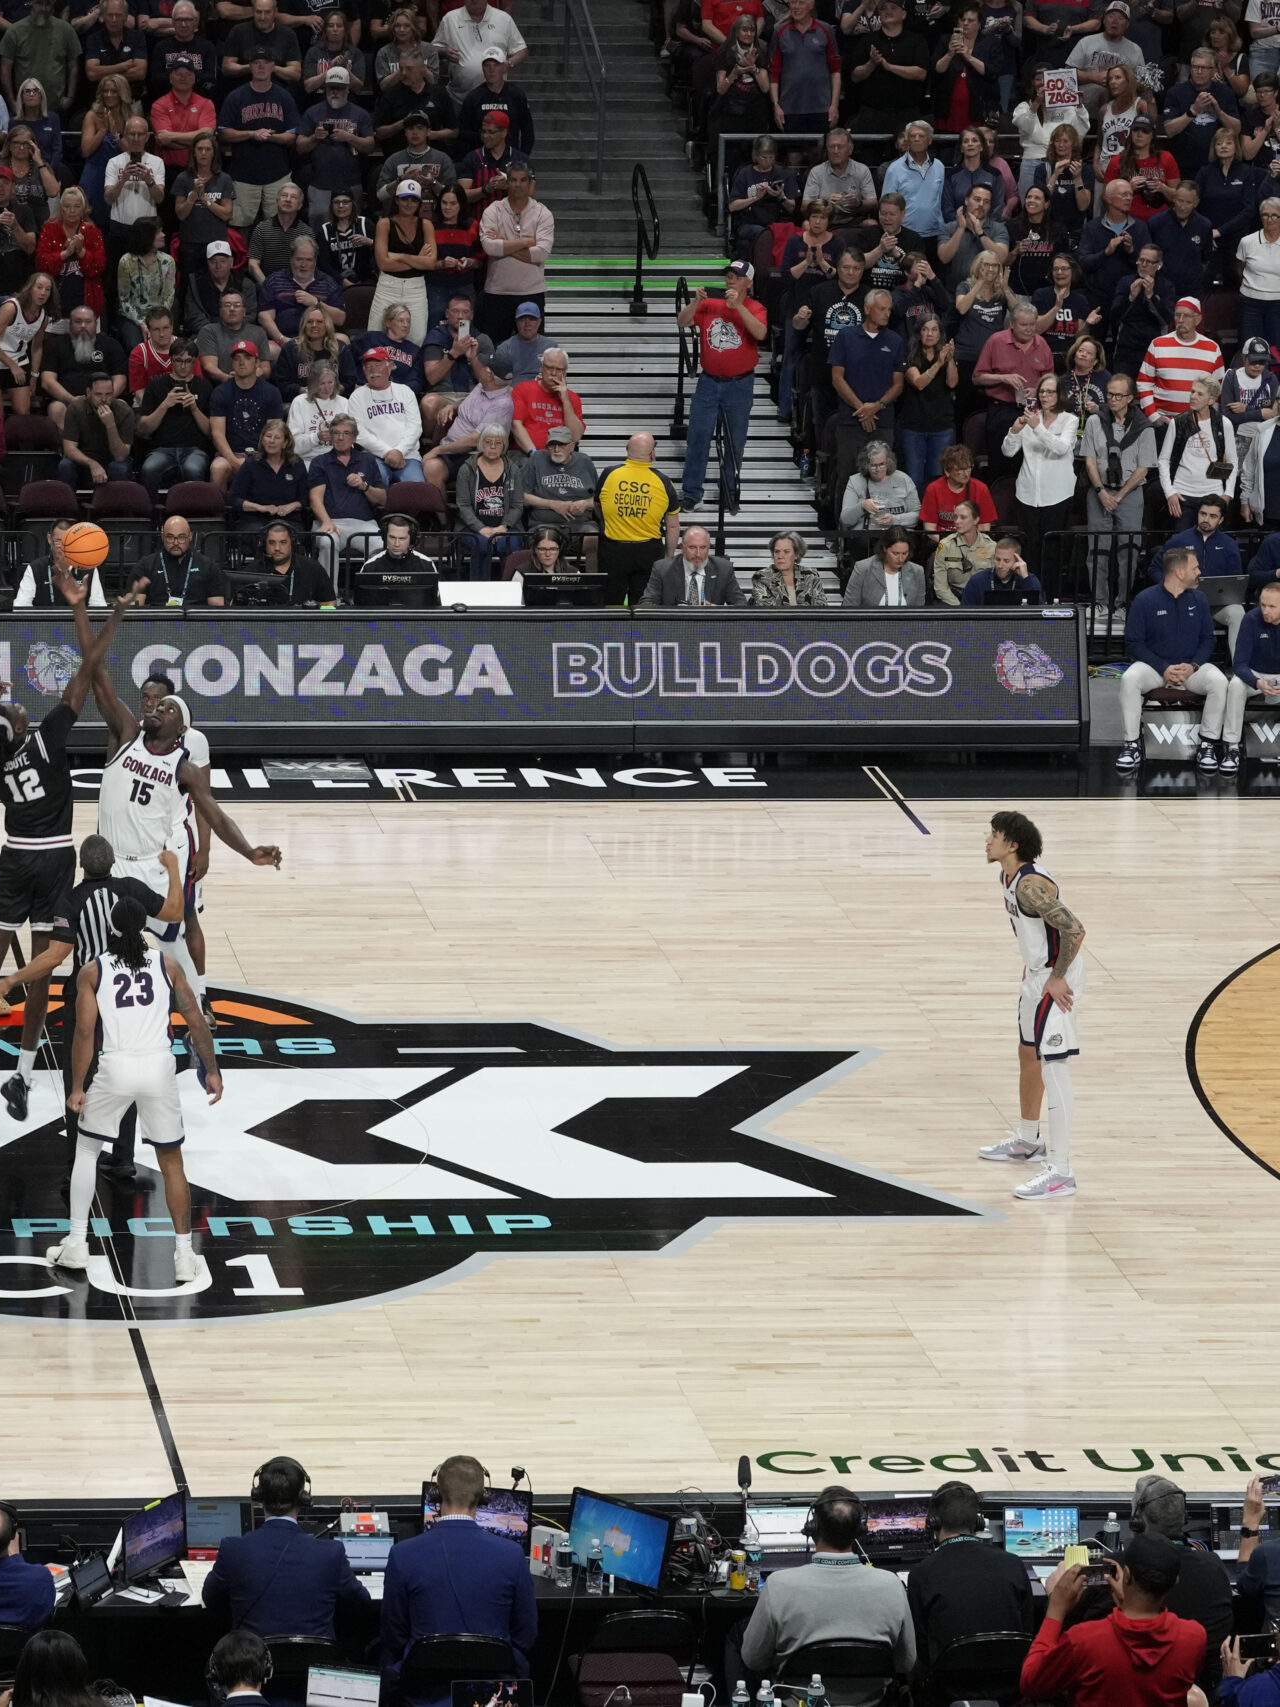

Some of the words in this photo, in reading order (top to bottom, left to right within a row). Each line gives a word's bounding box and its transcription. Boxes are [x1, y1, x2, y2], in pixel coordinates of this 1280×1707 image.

[1047, 79, 1064, 92] GO
[1048, 92, 1078, 105] ZAGS
[242, 102, 284, 124] GONZAGA
[407, 183, 416, 193] G
[341, 253, 357, 270] 27
[1055, 309, 1073, 321] GO
[367, 402, 406, 420] GONZAGA
[542, 474, 585, 489] GONZAGA
[618, 480, 651, 494] CSC
[614, 493, 653, 508] SECURITY
[617, 506, 648, 518] STAFF
[131, 643, 514, 698] GONZAGA
[552, 642, 953, 698] BULLDOGS
[122, 755, 174, 788] GONZAGA
[267, 760, 362, 771] WCC
[4, 767, 46, 804] 12
[129, 777, 155, 806] 15
[112, 971, 155, 1009] 23
[754, 1447, 1068, 1475] Credit
[821, 1558, 838, 1566] COAST
